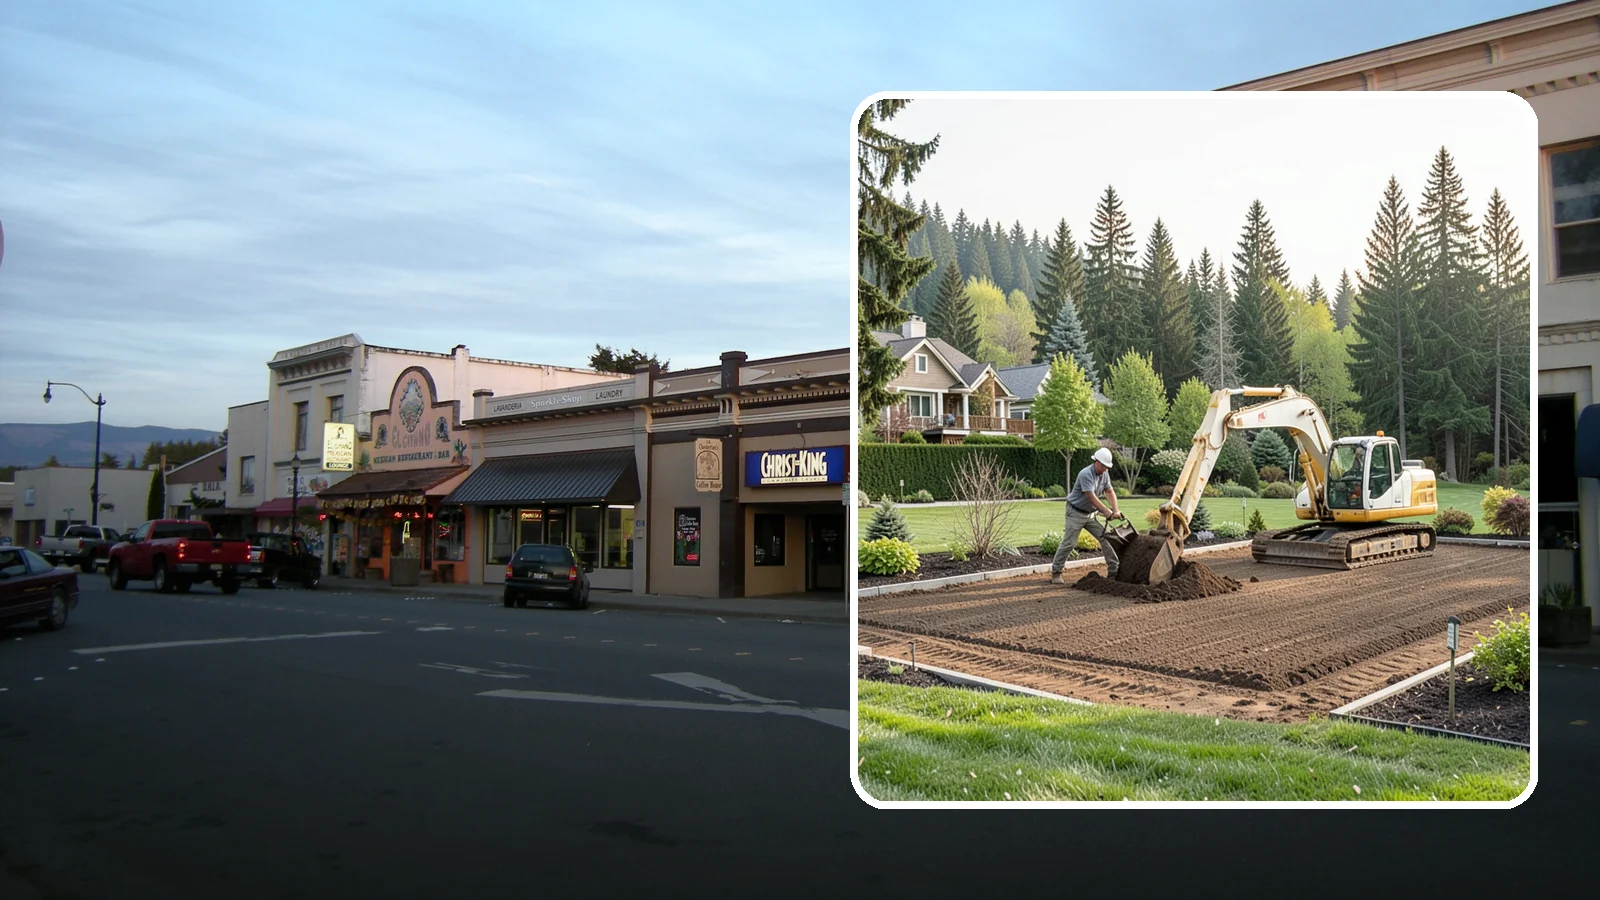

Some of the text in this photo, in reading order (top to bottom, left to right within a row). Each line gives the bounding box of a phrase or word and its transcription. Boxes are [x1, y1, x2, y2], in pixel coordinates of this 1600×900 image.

[595, 388, 623, 400] LAUNDRY
[493, 402, 522, 413] LAVANDERIA
[530, 394, 582, 409] Sparkle Shop
[373, 455, 396, 465] MEXICAN
[397, 451, 433, 463] RESTAURANT
[437, 450, 450, 459] BAR
[760, 450, 827, 478] CHRIST KING
[697, 480, 722, 489] Coffee House
